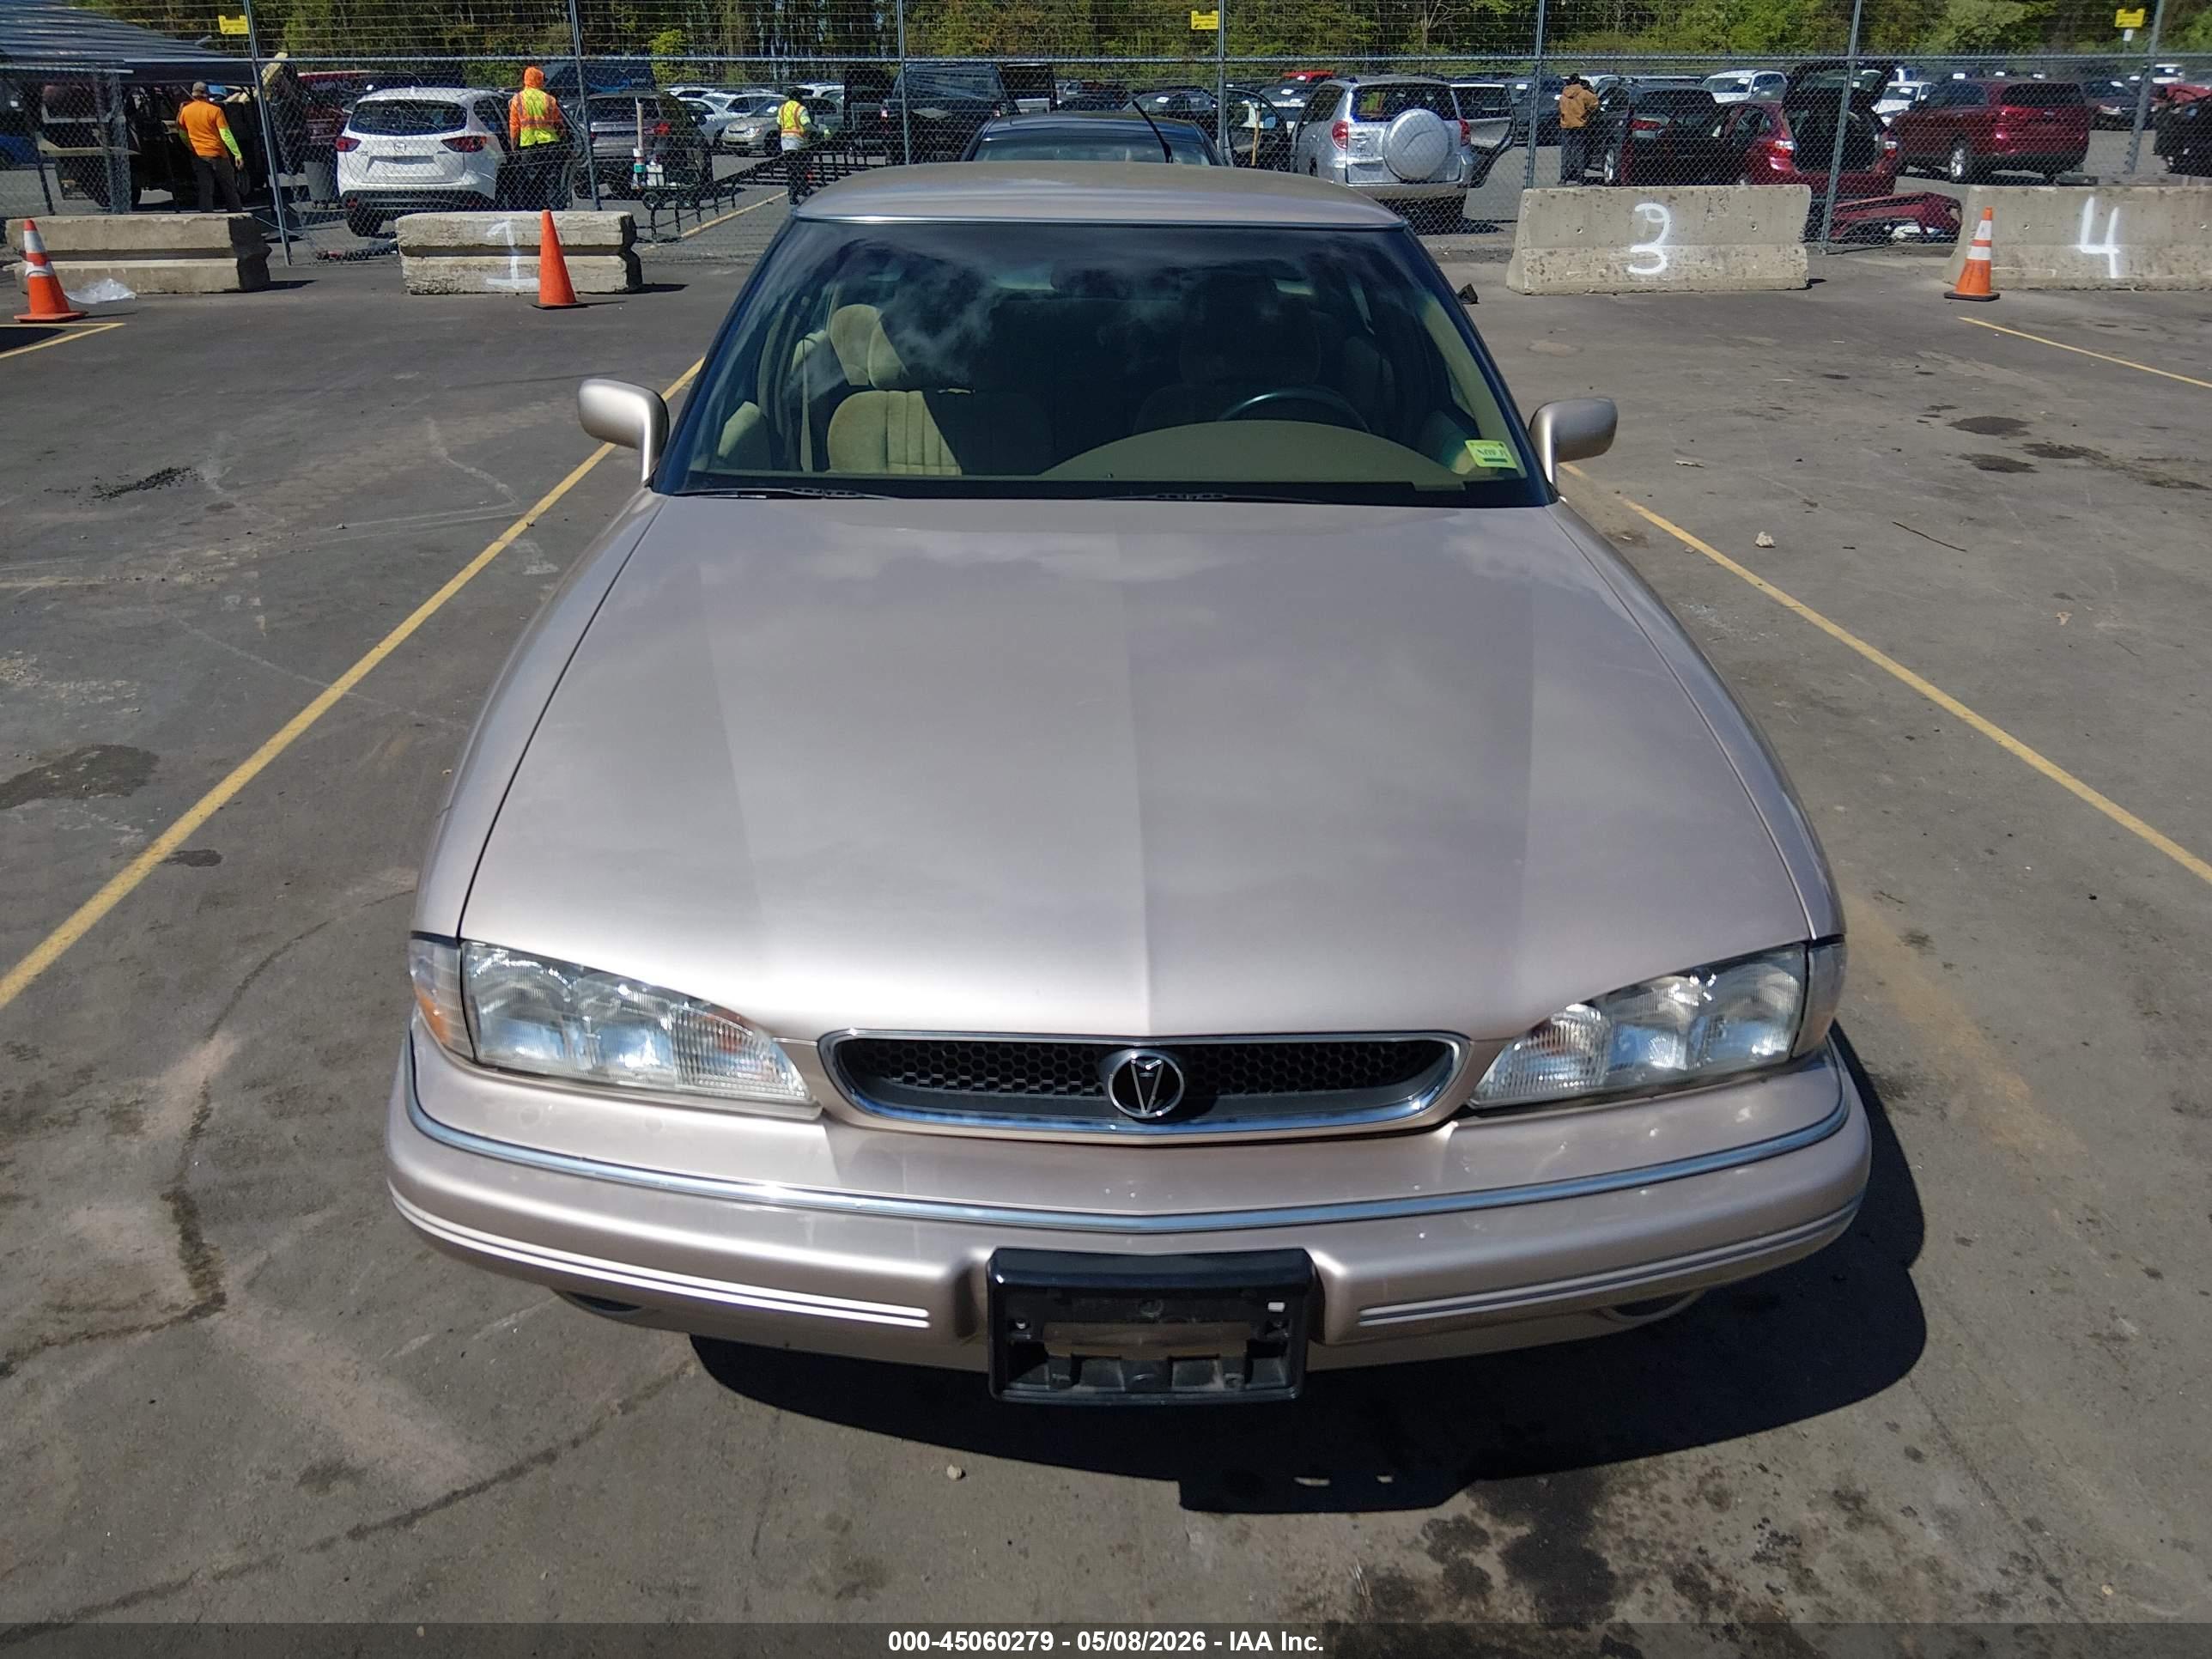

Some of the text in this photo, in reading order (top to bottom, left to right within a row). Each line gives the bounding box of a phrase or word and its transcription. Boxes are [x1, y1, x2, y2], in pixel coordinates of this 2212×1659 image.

[486, 221, 539, 289] 1
[1628, 203, 1670, 274] 3
[2076, 196, 2120, 279] 4
